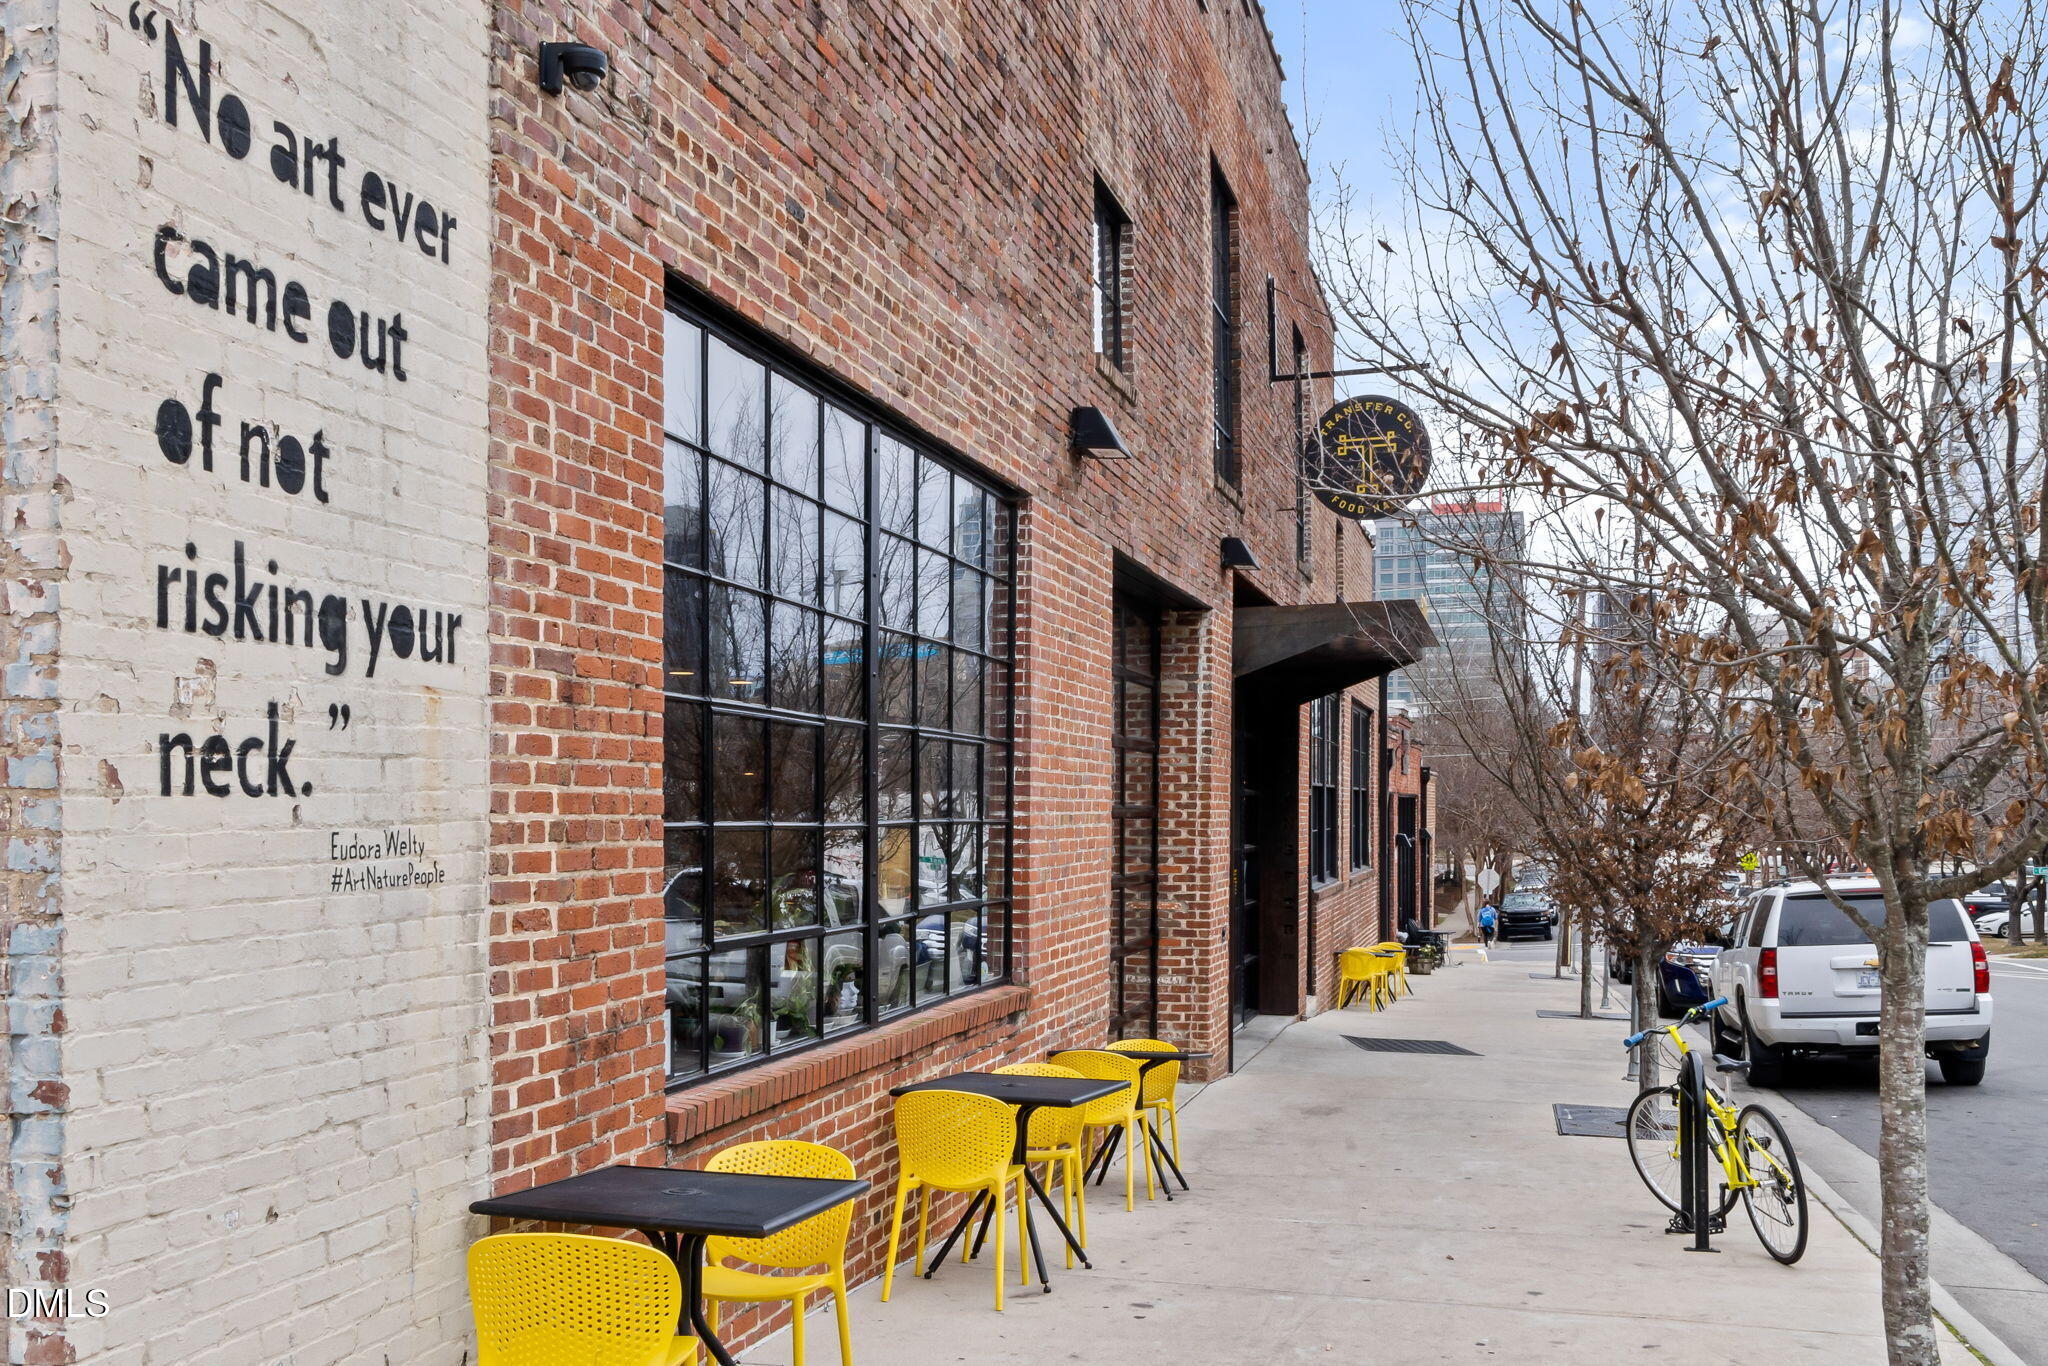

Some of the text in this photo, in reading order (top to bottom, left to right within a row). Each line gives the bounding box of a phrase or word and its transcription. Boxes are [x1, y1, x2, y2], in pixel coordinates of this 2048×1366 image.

[270, 120, 346, 213] art
[360, 171, 457, 265] ever
[154, 226, 408, 382] came out
[155, 373, 330, 504] of not
[1320, 402, 1394, 436] TRANSFER
[1331, 495, 1365, 514] FOOD
[157, 540, 462, 678] risking your
[331, 827, 425, 863] Eudora Welty
[331, 861, 446, 893] #ArtNaturePeople
